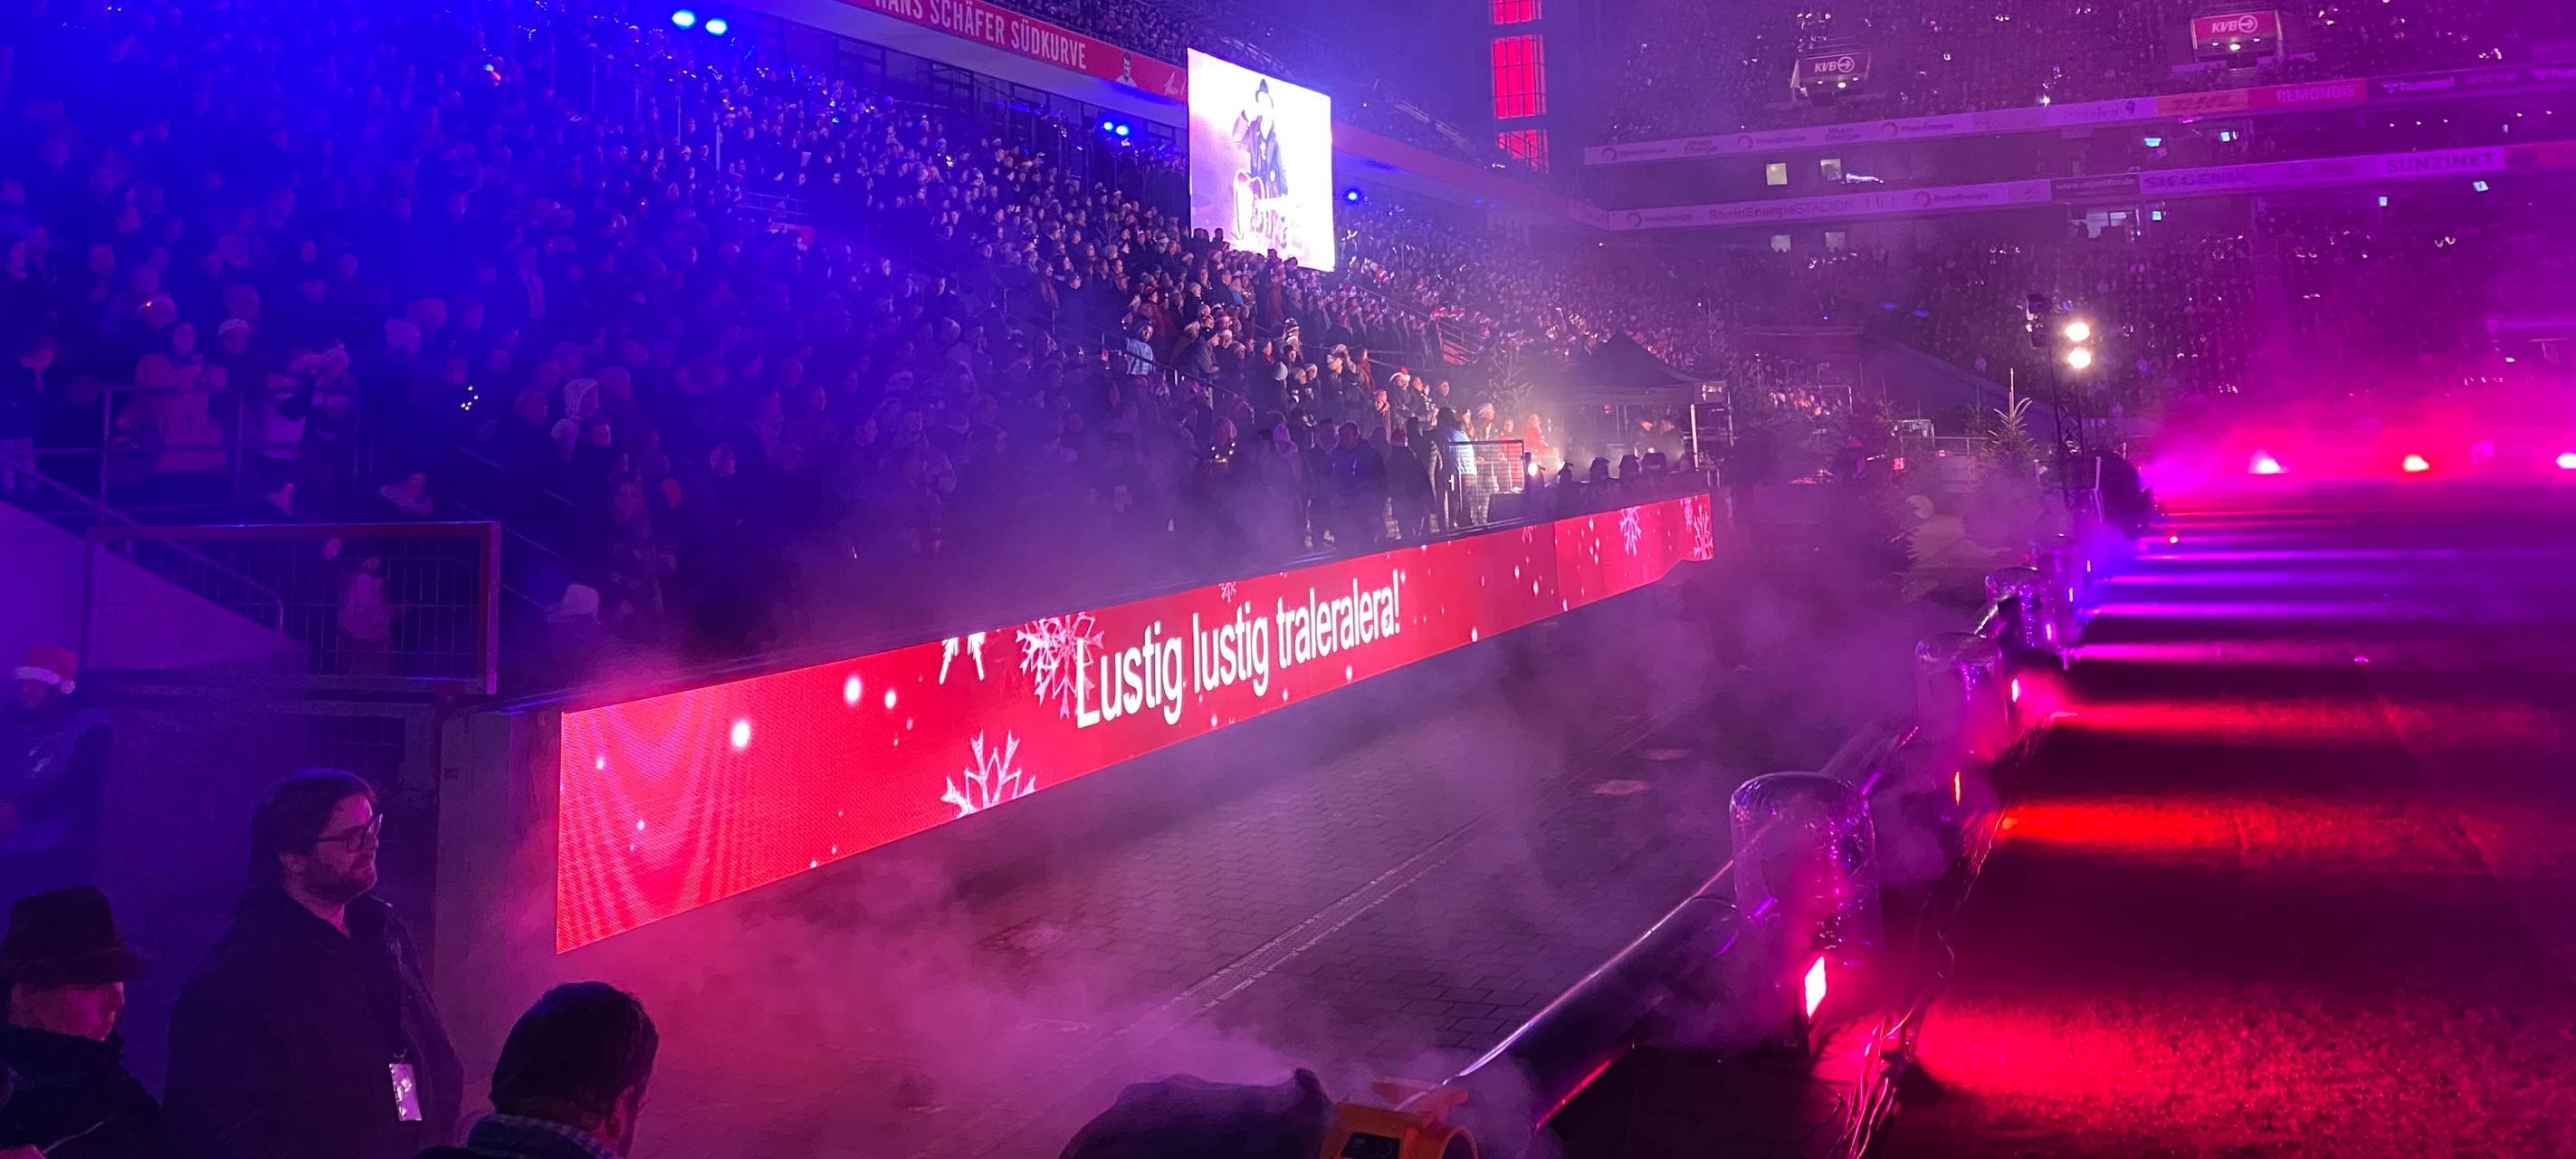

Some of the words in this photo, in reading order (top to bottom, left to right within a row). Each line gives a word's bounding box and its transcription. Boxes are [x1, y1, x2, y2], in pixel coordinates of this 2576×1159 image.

[930, 0, 1007, 44] SCHÄFER
[1010, 17, 1087, 70] SÜDKURVE
[2211, 21, 2237, 33] KVB
[1814, 61, 1837, 72] KVB
[2275, 84, 2356, 102] REMONDIS
[2387, 152, 2495, 172] SUNZINET
[1075, 620, 1183, 729] Lustig
[1192, 600, 1268, 697] lustig
[1276, 569, 1401, 669] traleralera!
